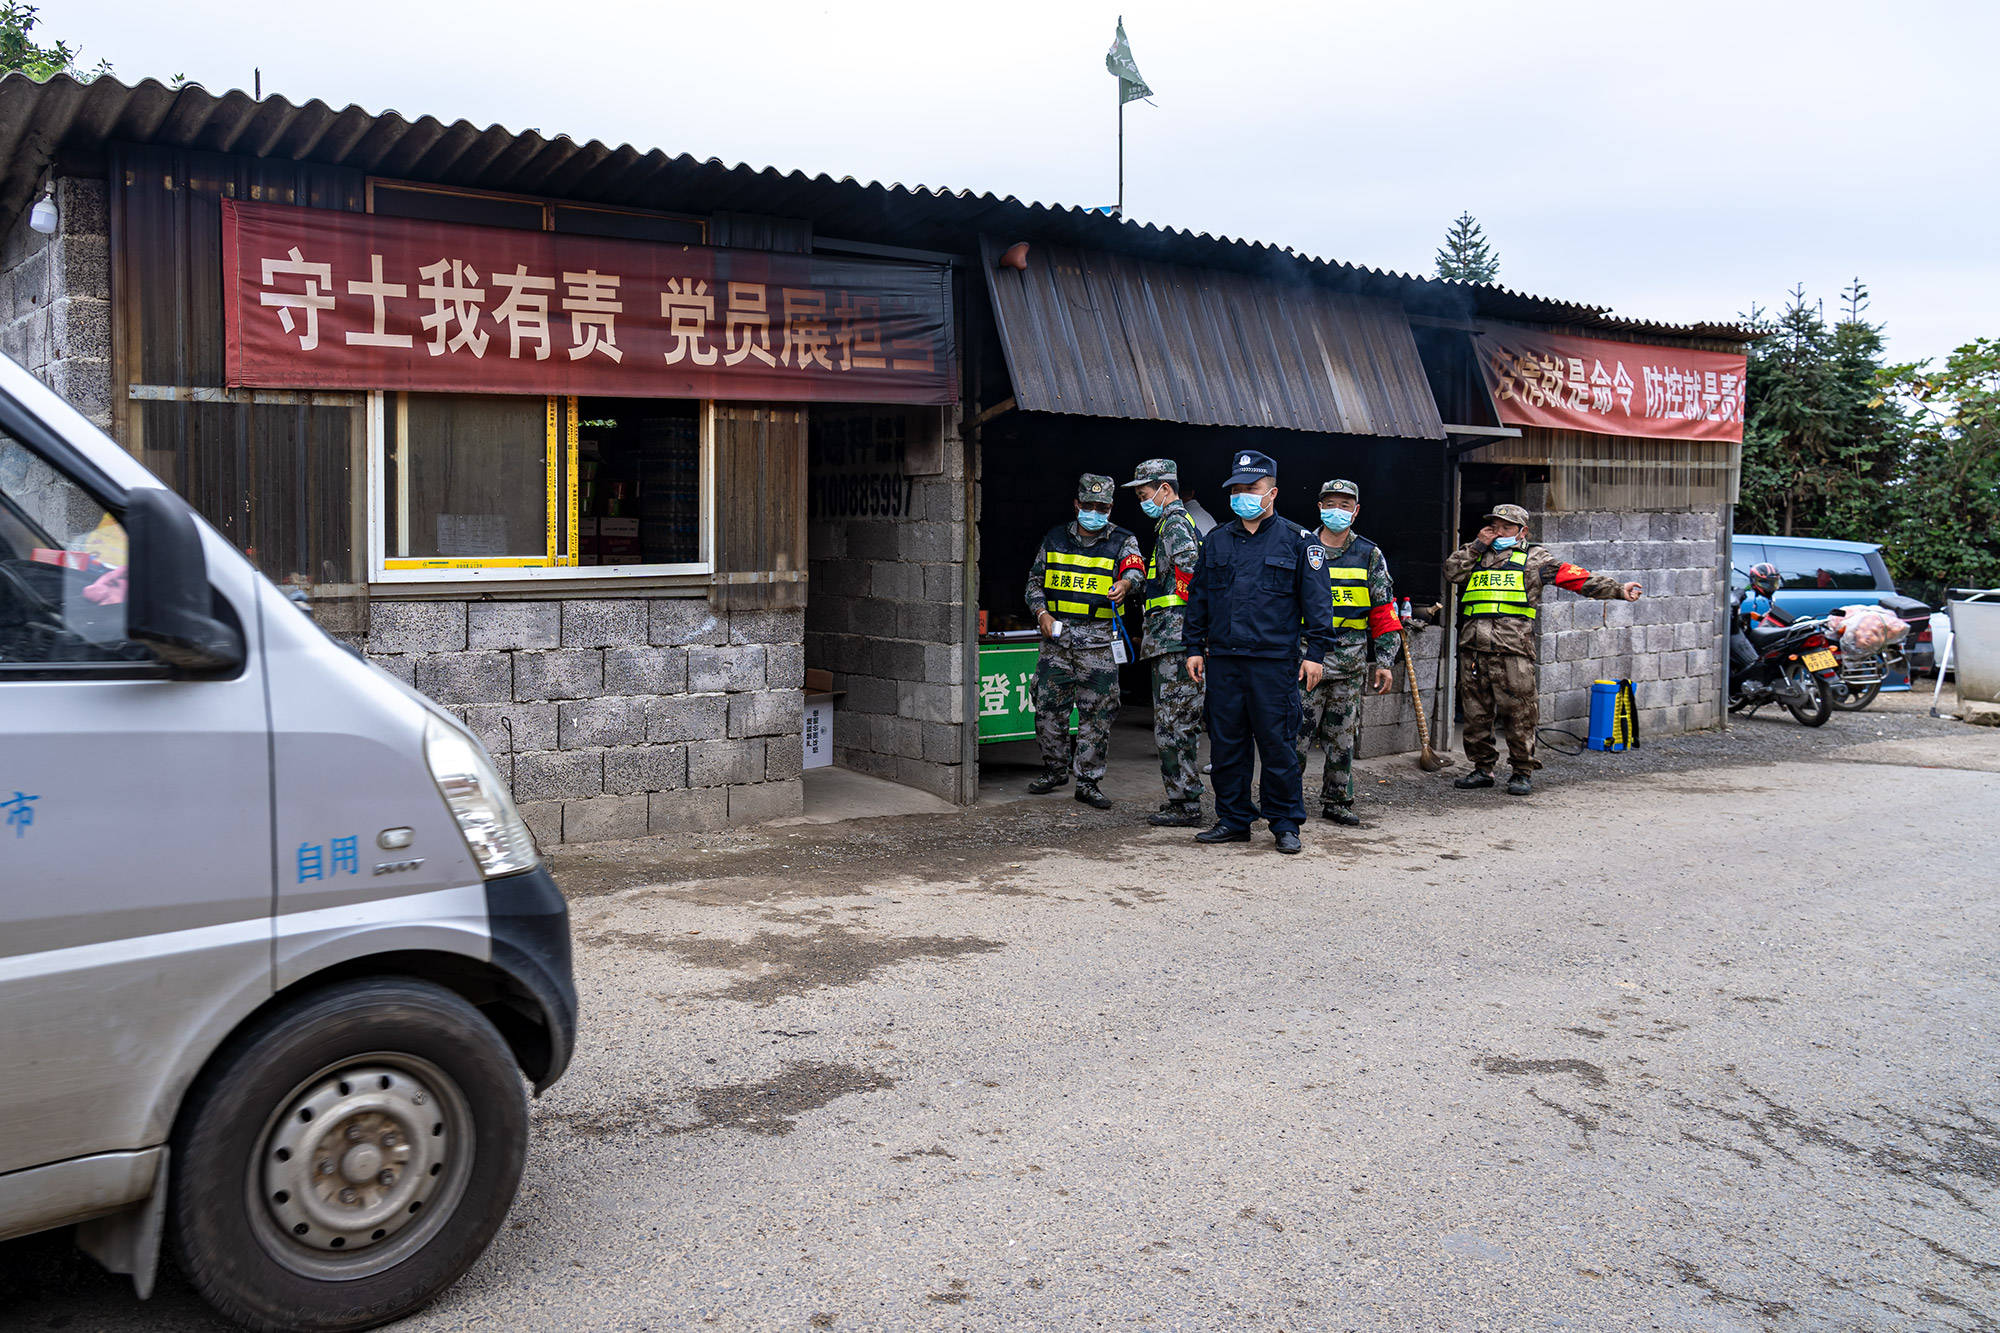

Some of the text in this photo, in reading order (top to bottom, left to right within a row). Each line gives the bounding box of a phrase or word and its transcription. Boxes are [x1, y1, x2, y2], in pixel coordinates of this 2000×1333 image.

[259, 246, 623, 364] 守土我有责
[1051, 574, 1098, 590] 龙陵民兵
[297, 835, 358, 883] 自用
